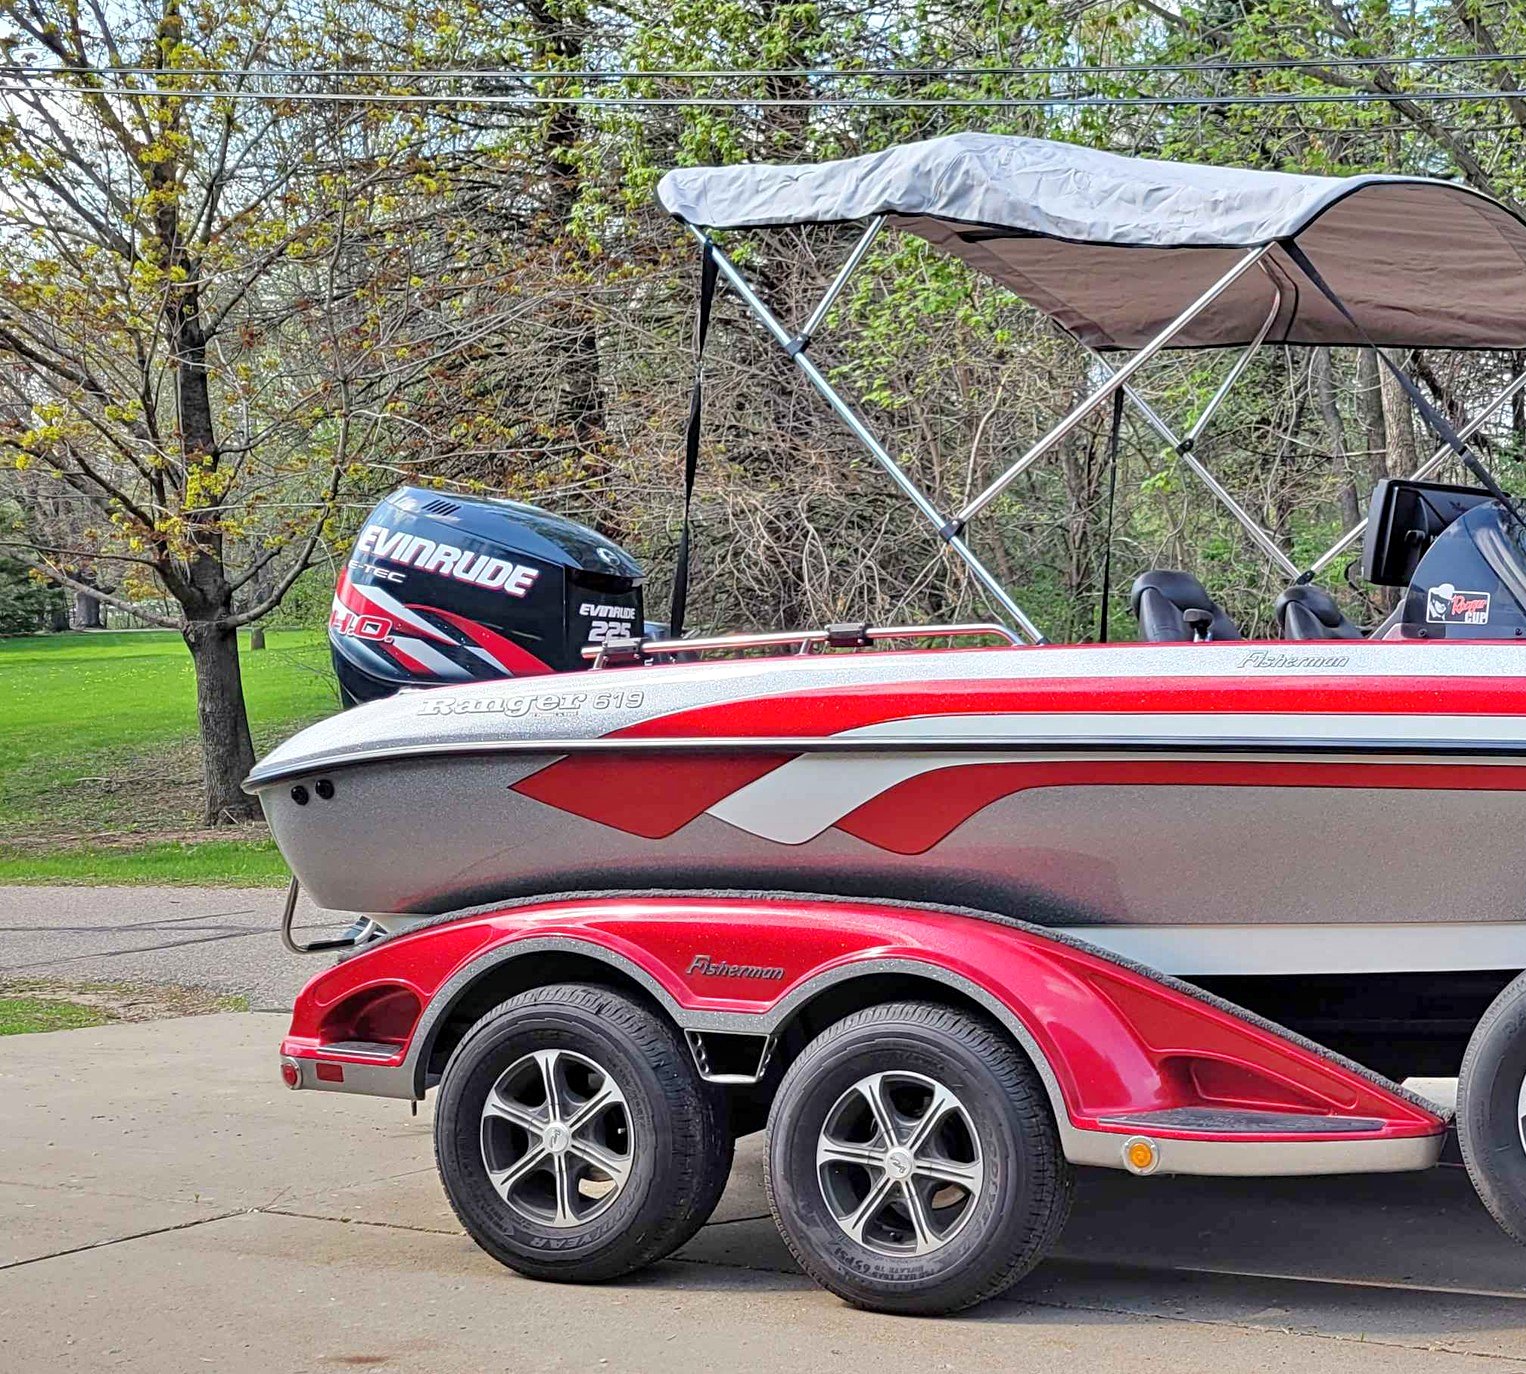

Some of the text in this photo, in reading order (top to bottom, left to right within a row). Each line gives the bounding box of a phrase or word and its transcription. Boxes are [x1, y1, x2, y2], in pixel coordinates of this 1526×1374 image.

[350, 559, 406, 583] E-TEC
[358, 525, 541, 598] EVINRUDE
[579, 603, 636, 619] EVINRUDE
[1465, 611, 1488, 624] CUP
[588, 620, 631, 642] 225
[1237, 650, 1350, 668] Fisherman
[417, 690, 645, 718] Ranger 619
[686, 954, 785, 981] Fisherman
